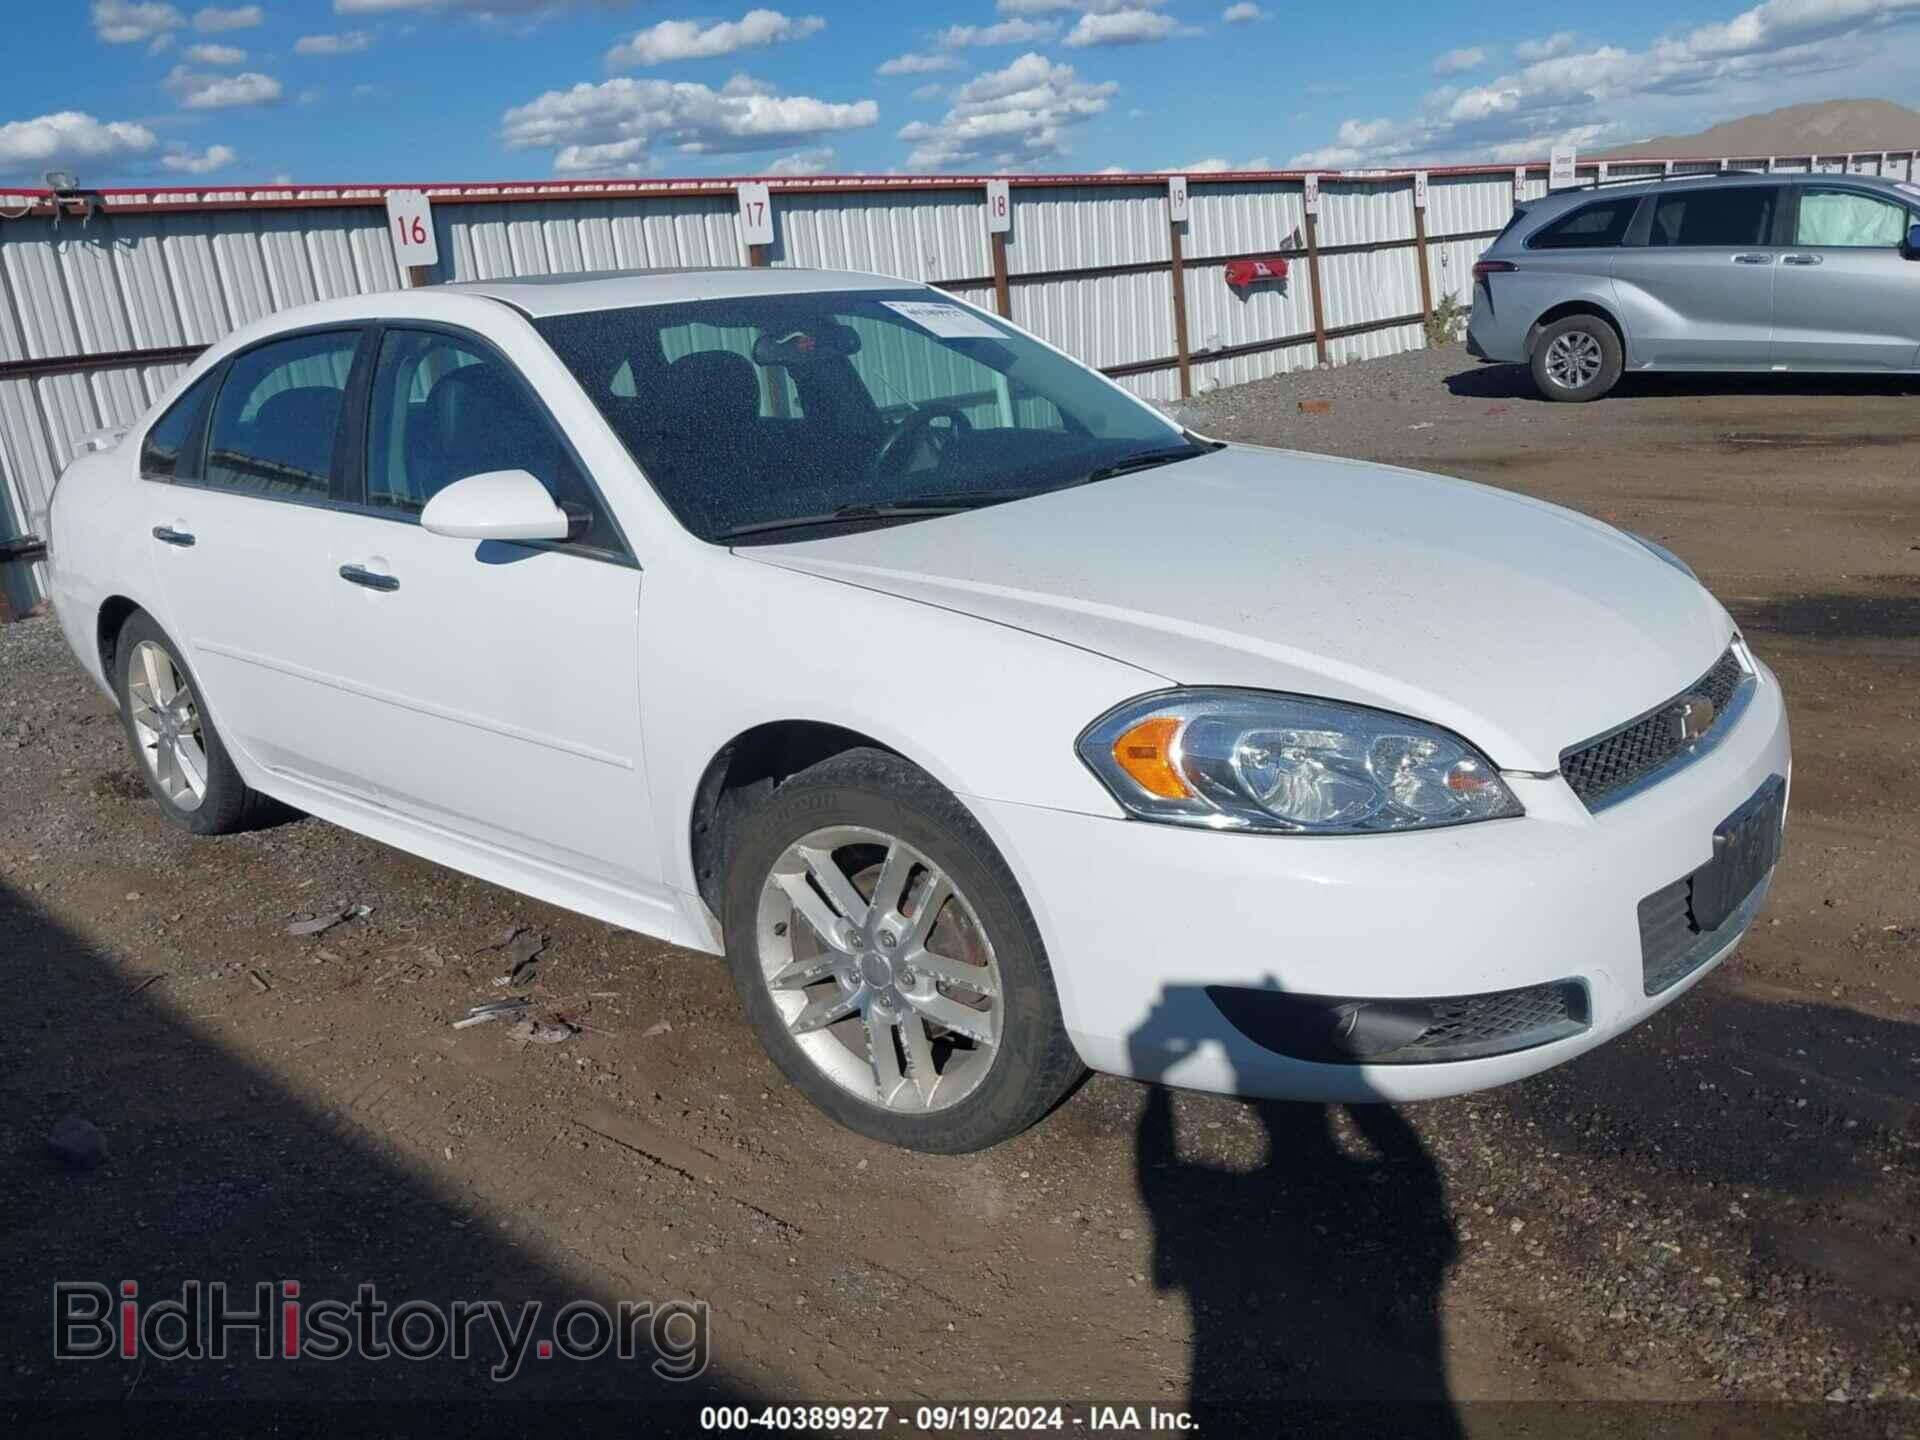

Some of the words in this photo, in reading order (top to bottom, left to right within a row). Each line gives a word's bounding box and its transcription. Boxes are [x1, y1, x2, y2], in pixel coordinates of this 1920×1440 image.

[991, 195, 1006, 218] 18
[1172, 189, 1184, 207] 19
[746, 202, 764, 227] 17
[397, 215, 427, 246] 16
